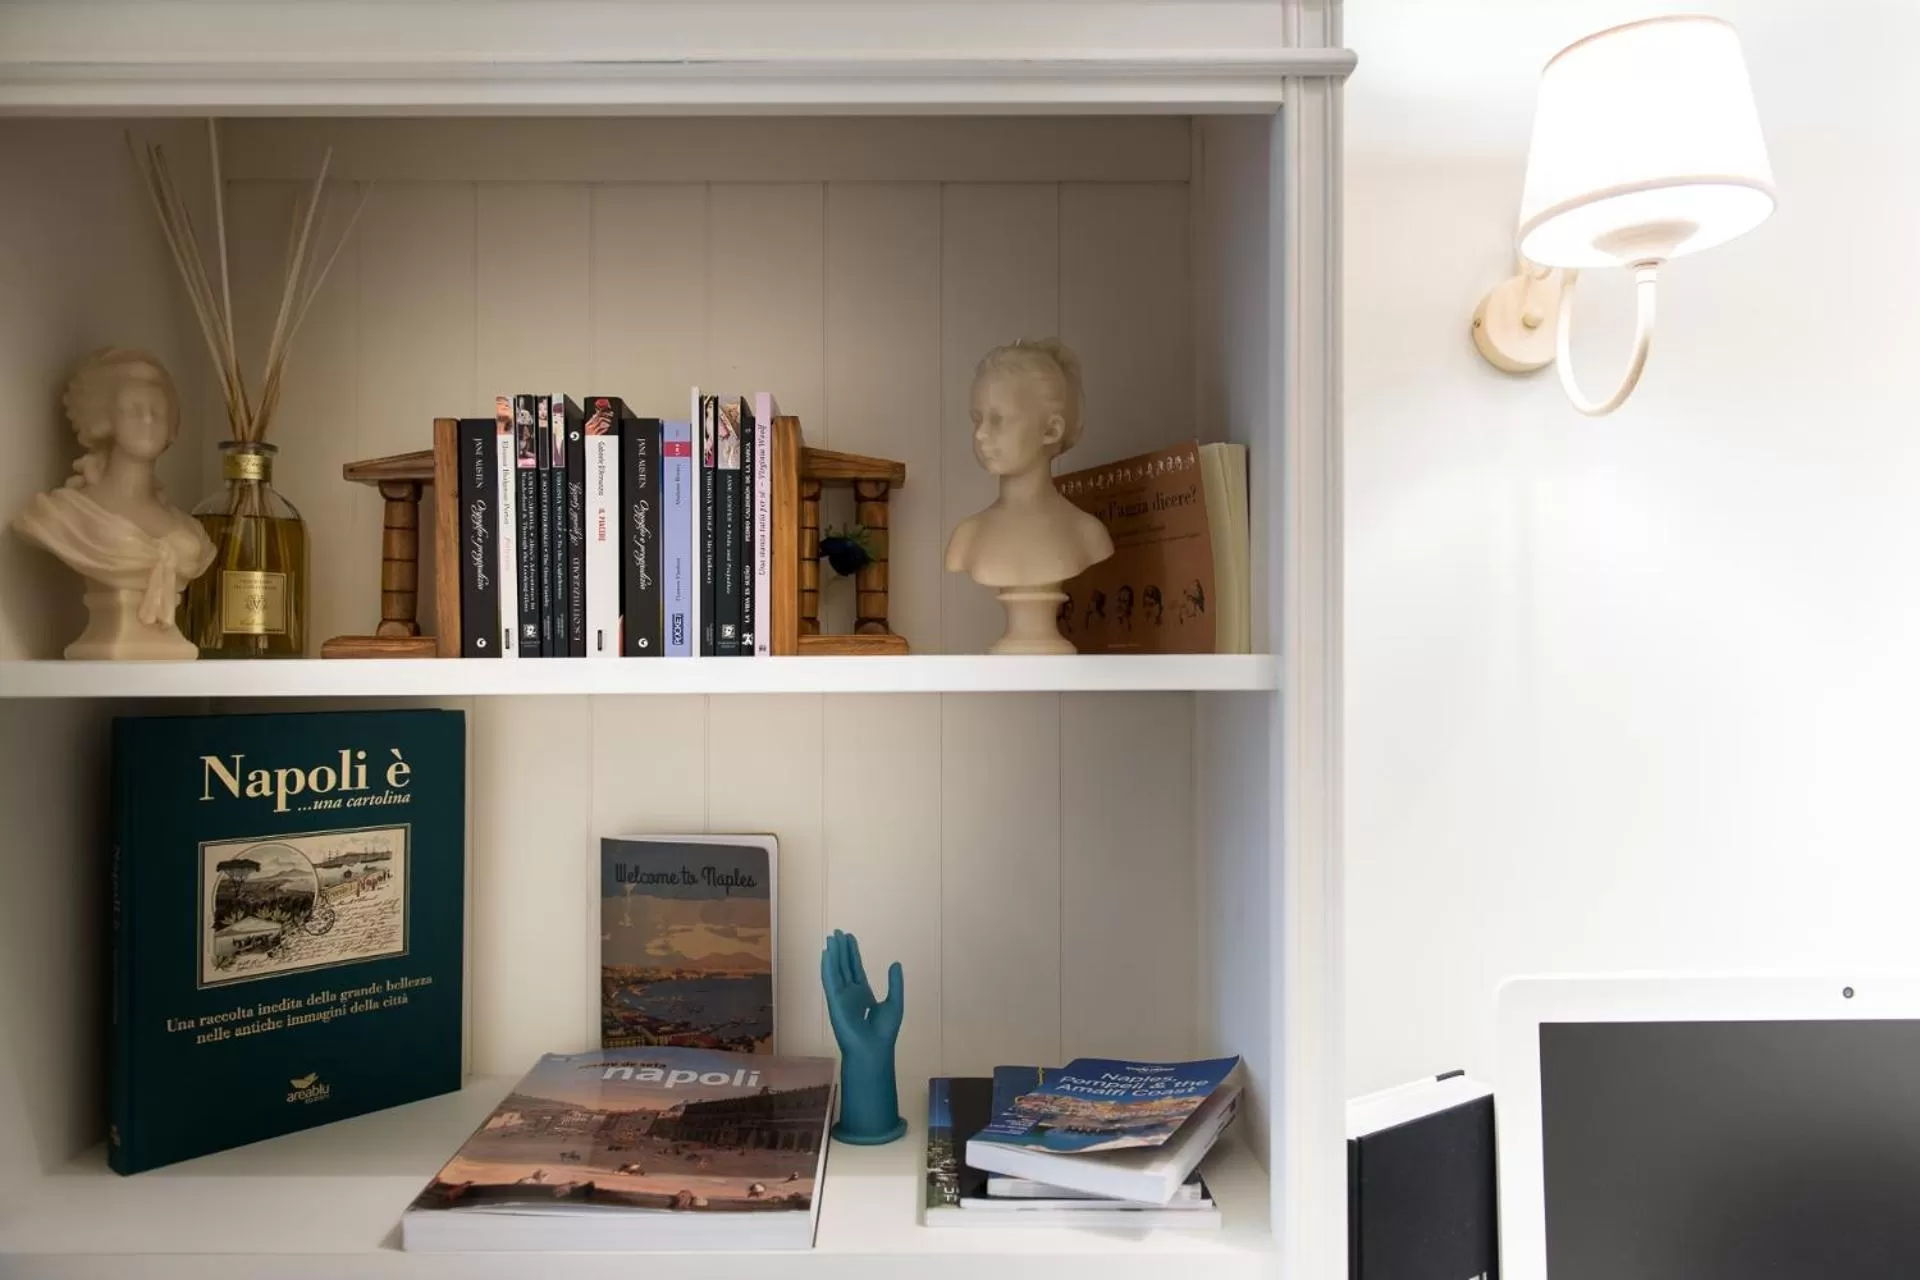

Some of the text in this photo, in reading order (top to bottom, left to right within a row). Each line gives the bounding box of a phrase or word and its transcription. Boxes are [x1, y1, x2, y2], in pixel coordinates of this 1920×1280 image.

[472, 438, 484, 489] JANE AUSTEN
[636, 438, 646, 489] JANE AUSTEN
[634, 500, 652, 537] Orgoglio
[199, 748, 411, 813] Napoli è
[346, 790, 411, 808] cartolina
[615, 863, 759, 895] Welcome to Naples
[166, 975, 433, 1033] Una raccolta inedita della grande bellezza
[196, 992, 409, 1045] nelle antiche immagini della città
[600, 1066, 761, 1088] napoli
[1056, 1083, 1198, 1096] Amalfi Coast
[1060, 1076, 1209, 1089] Pompeii & the
[1101, 1073, 1177, 1083] Naples,
